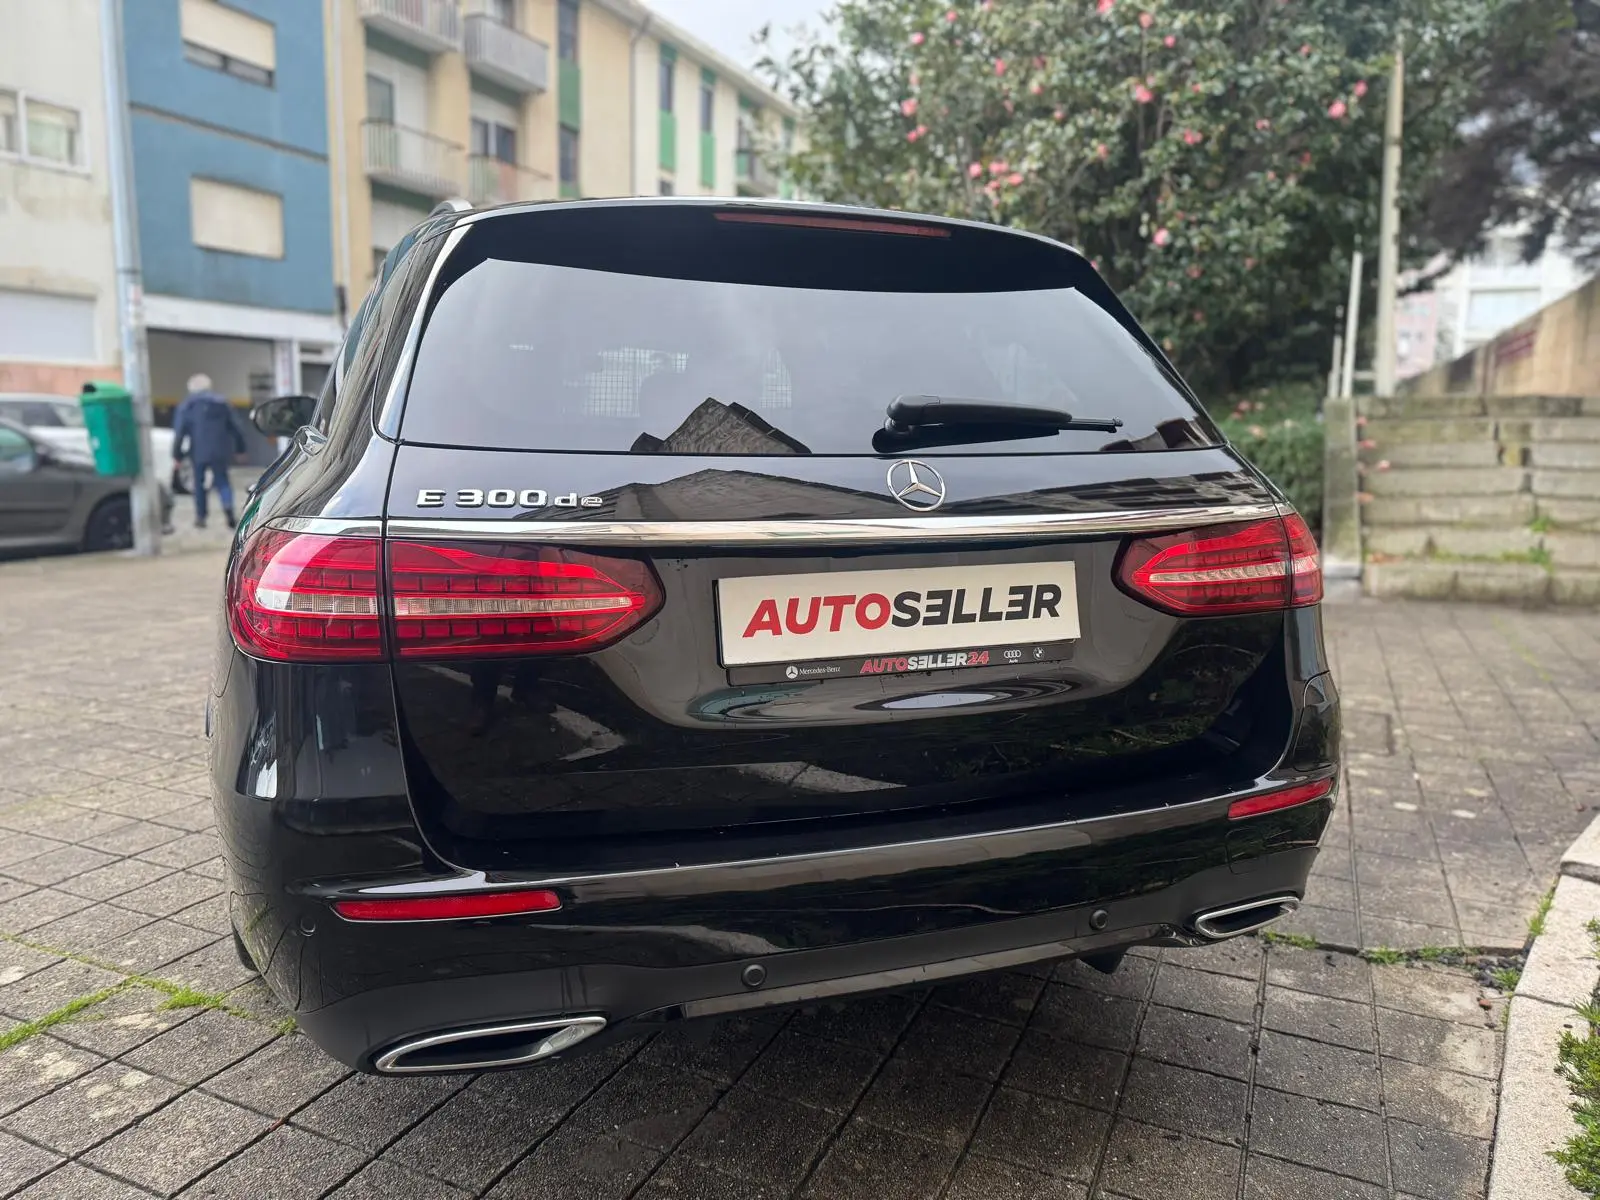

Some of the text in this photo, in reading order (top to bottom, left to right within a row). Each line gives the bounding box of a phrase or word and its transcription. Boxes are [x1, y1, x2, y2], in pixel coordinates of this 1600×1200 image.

[416, 489, 447, 507] E
[742, 583, 1062, 638] AUTOSELLER
[799, 666, 840, 675] Mercedes-Benz
